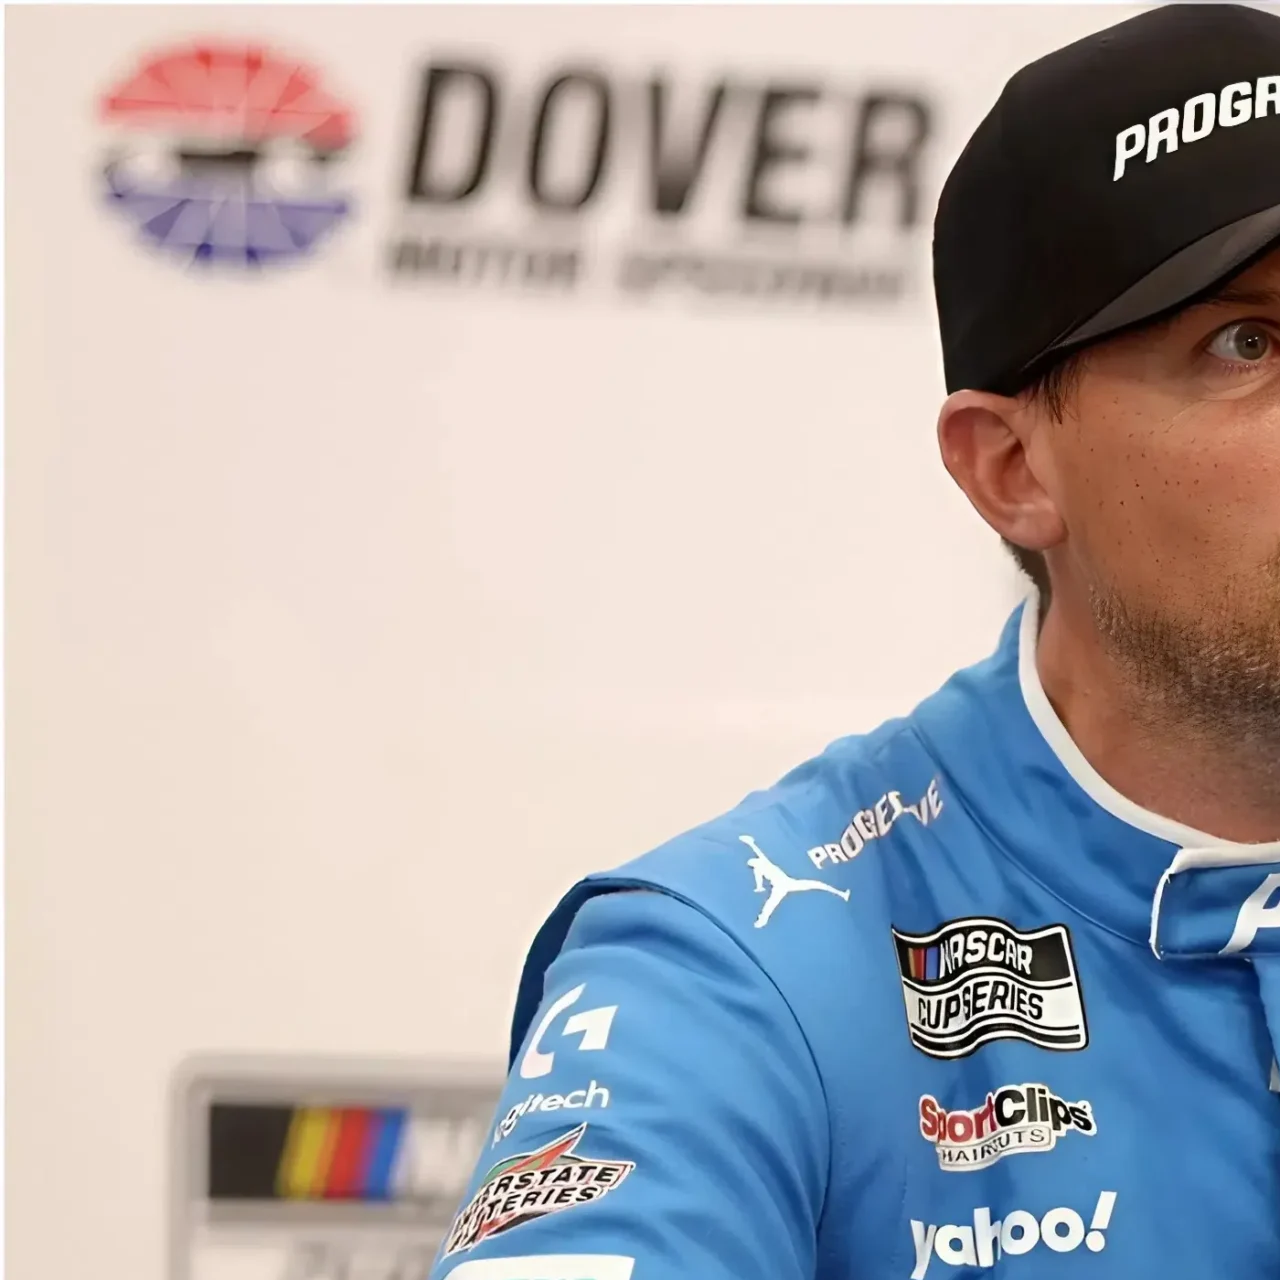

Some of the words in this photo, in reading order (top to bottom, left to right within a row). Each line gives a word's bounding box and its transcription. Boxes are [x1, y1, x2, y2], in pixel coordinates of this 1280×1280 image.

[407, 60, 932, 230] DOVER
[938, 930, 1033, 980] NASCAR
[909, 1191, 1118, 1280] yahoo!
